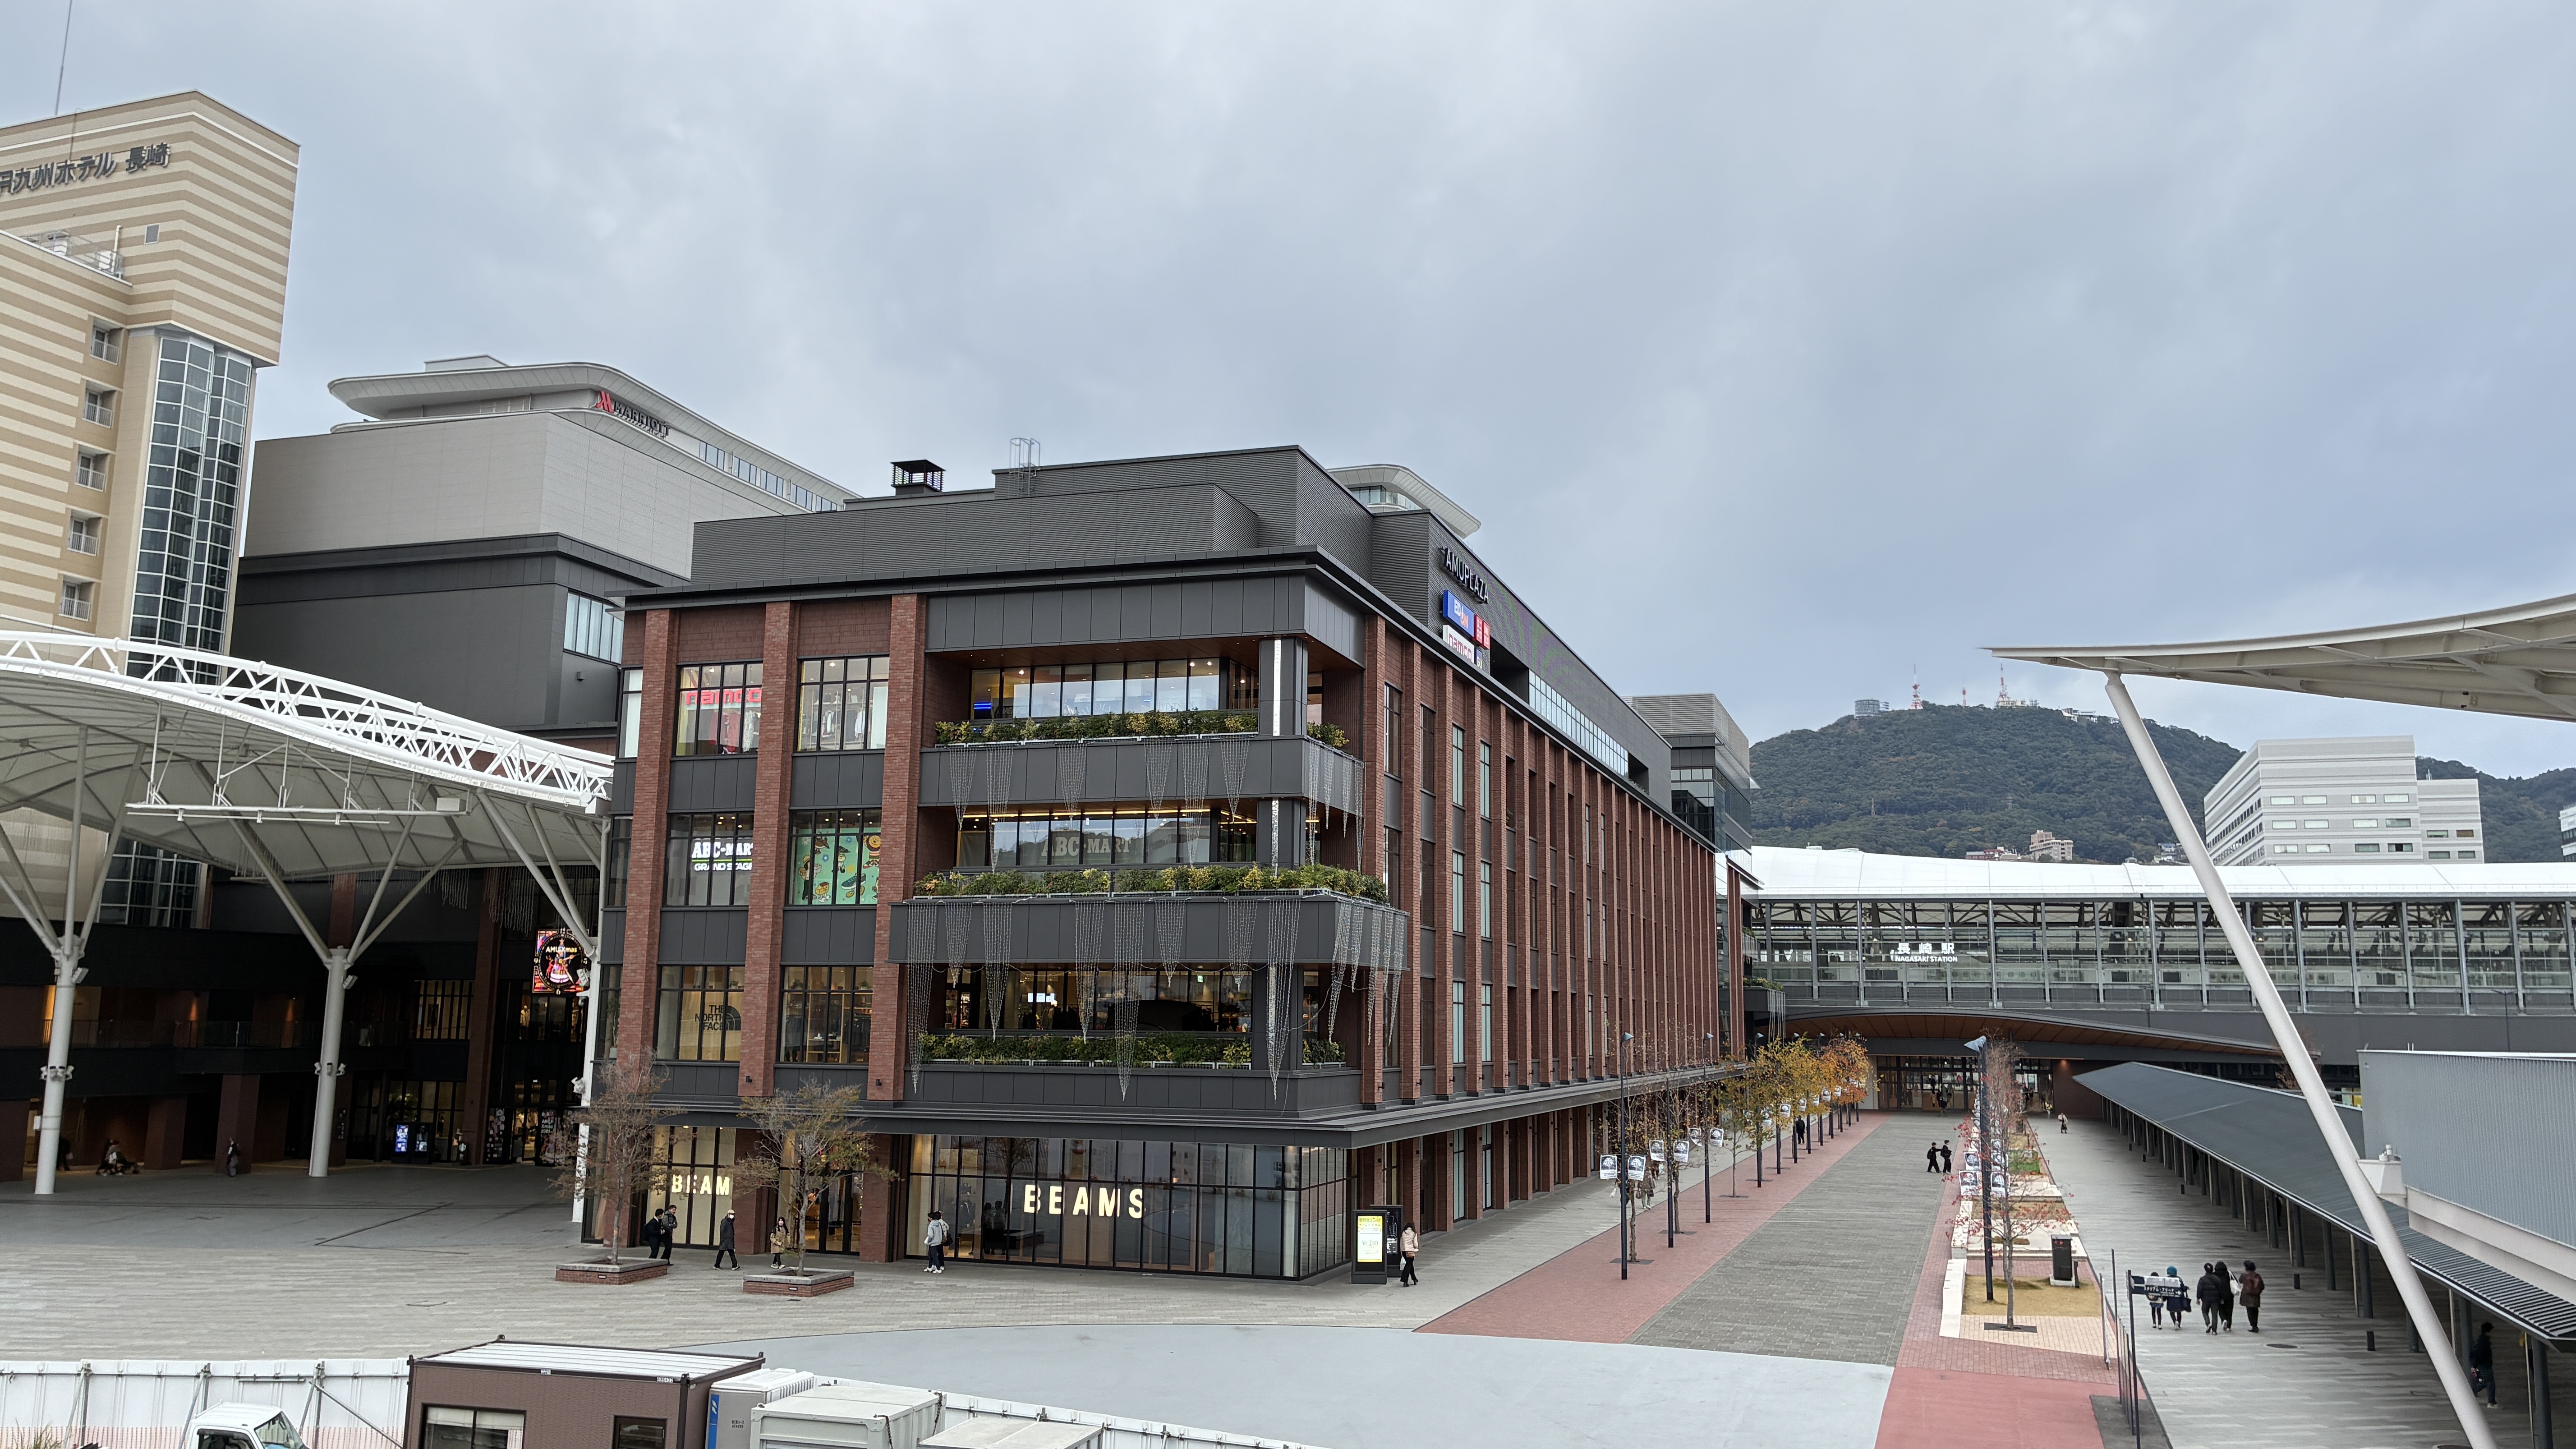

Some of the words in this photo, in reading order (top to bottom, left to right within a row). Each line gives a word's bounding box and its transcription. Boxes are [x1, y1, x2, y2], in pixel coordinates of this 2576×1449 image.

[125, 142, 170, 173] 長崎
[686, 689, 762, 705] namco
[1041, 836, 1131, 856] ABC-MART
[1897, 942, 1955, 955] 長崎駅
[1024, 1184, 1145, 1219] BEAMS
